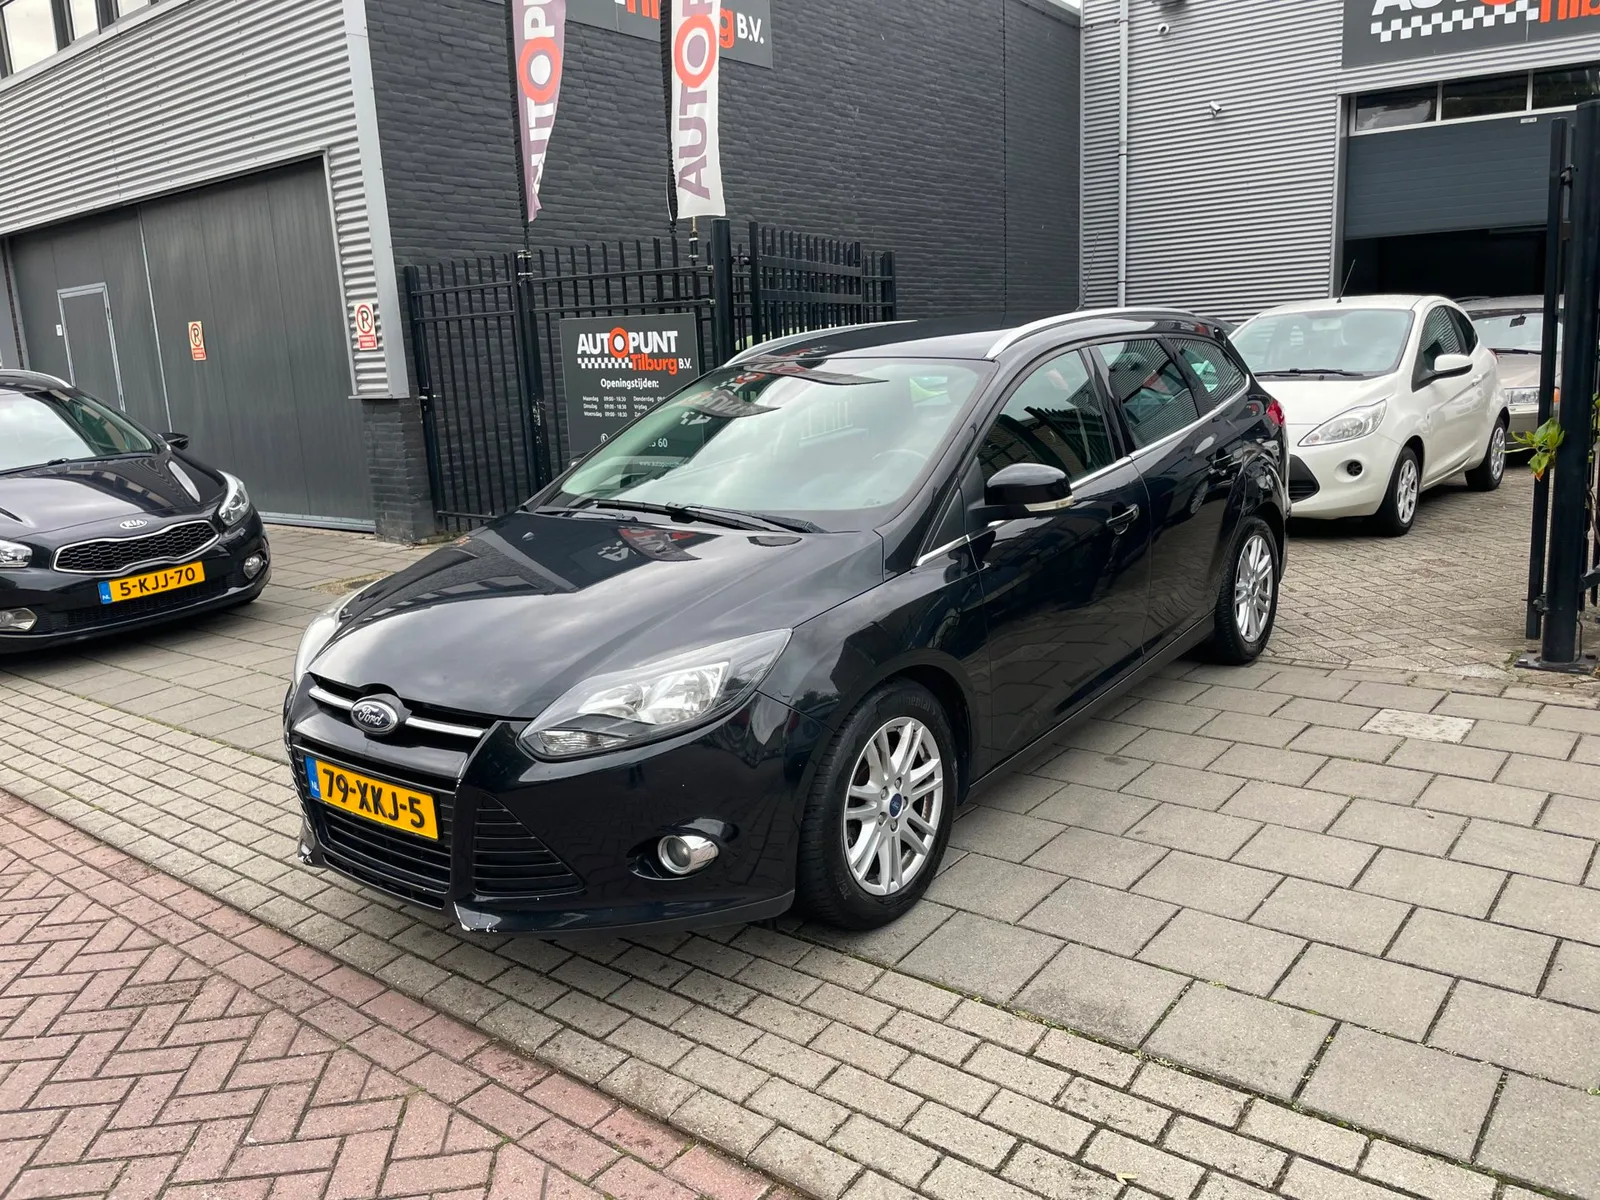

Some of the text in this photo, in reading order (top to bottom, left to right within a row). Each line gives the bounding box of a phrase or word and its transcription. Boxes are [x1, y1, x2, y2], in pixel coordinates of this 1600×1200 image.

[736, 12, 765, 44] B.V.
[577, 327, 678, 359] AUTOPUNT
[630, 353, 692, 376] Tilburg B.V.
[600, 378, 659, 390] Openingstijden:
[123, 519, 145, 528] KIA
[119, 567, 196, 597] 5-KJJ-70
[357, 704, 385, 726] Ford
[322, 768, 425, 828] 79-XKJ-5
